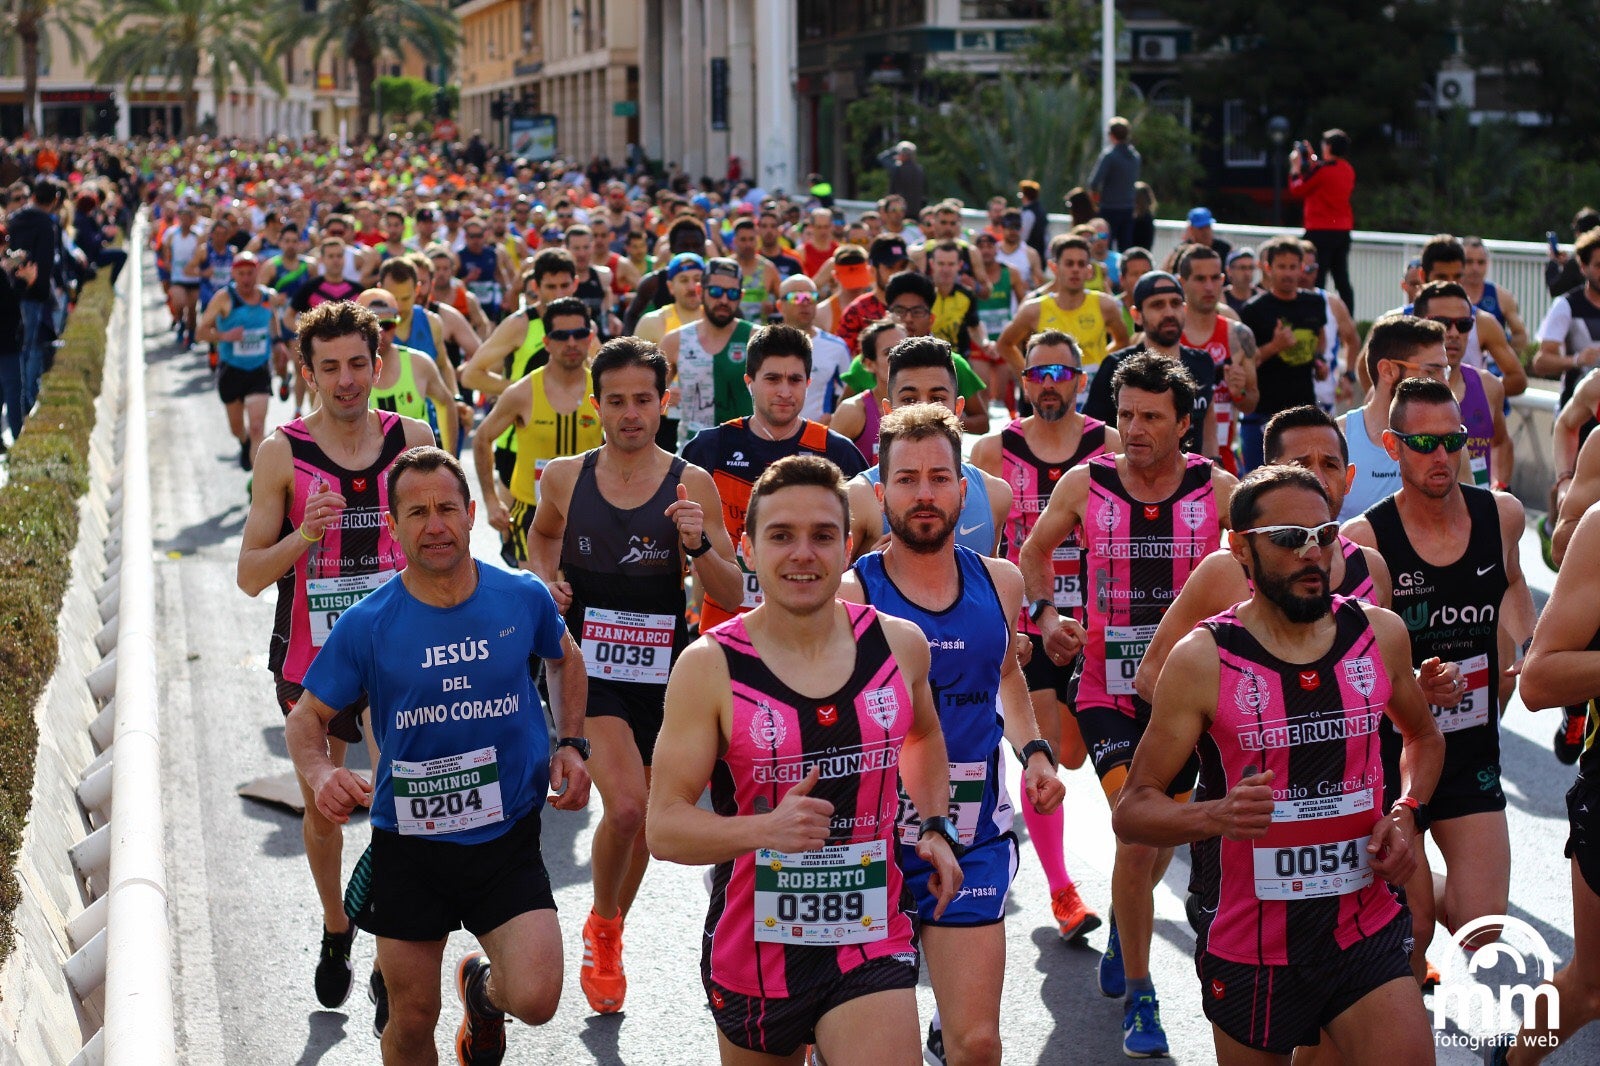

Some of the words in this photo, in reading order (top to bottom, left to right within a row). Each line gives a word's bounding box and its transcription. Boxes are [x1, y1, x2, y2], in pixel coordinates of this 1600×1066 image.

[1095, 542, 1142, 558] ELCHE
[1142, 542, 1206, 558] RUNNERS
[308, 554, 354, 568] Antonio
[1398, 570, 1424, 587] GS
[1098, 586, 1146, 600] Antonio
[1393, 588, 1414, 596] Gent
[1415, 585, 1435, 595] Sport
[1402, 600, 1494, 631] Urban
[586, 624, 670, 644] FRANMARCO
[422, 636, 490, 669] JESÚS
[595, 642, 655, 667] 0039
[1346, 664, 1373, 676] ELCHE
[1346, 672, 1377, 683] RUNNERS
[442, 676, 472, 692] DEL
[868, 695, 894, 707] ELCHE
[944, 691, 990, 706] TEAM
[396, 704, 448, 730] DIVINO
[450, 693, 520, 720] CORAZÓN
[867, 704, 899, 716] RUNNERS
[1238, 726, 1300, 752] ELCHE
[1302, 710, 1384, 742] RUNNERS
[826, 746, 838, 754] CA
[1102, 741, 1130, 754] mirca
[752, 762, 816, 784] ELCHE
[817, 744, 902, 780] RUNNERS
[408, 771, 480, 794] DOMINGO
[410, 788, 482, 819] 0204
[1275, 840, 1360, 877] 0054
[777, 868, 866, 889] ROBERTO
[972, 884, 997, 898] rasán
[777, 891, 864, 922] 0389
